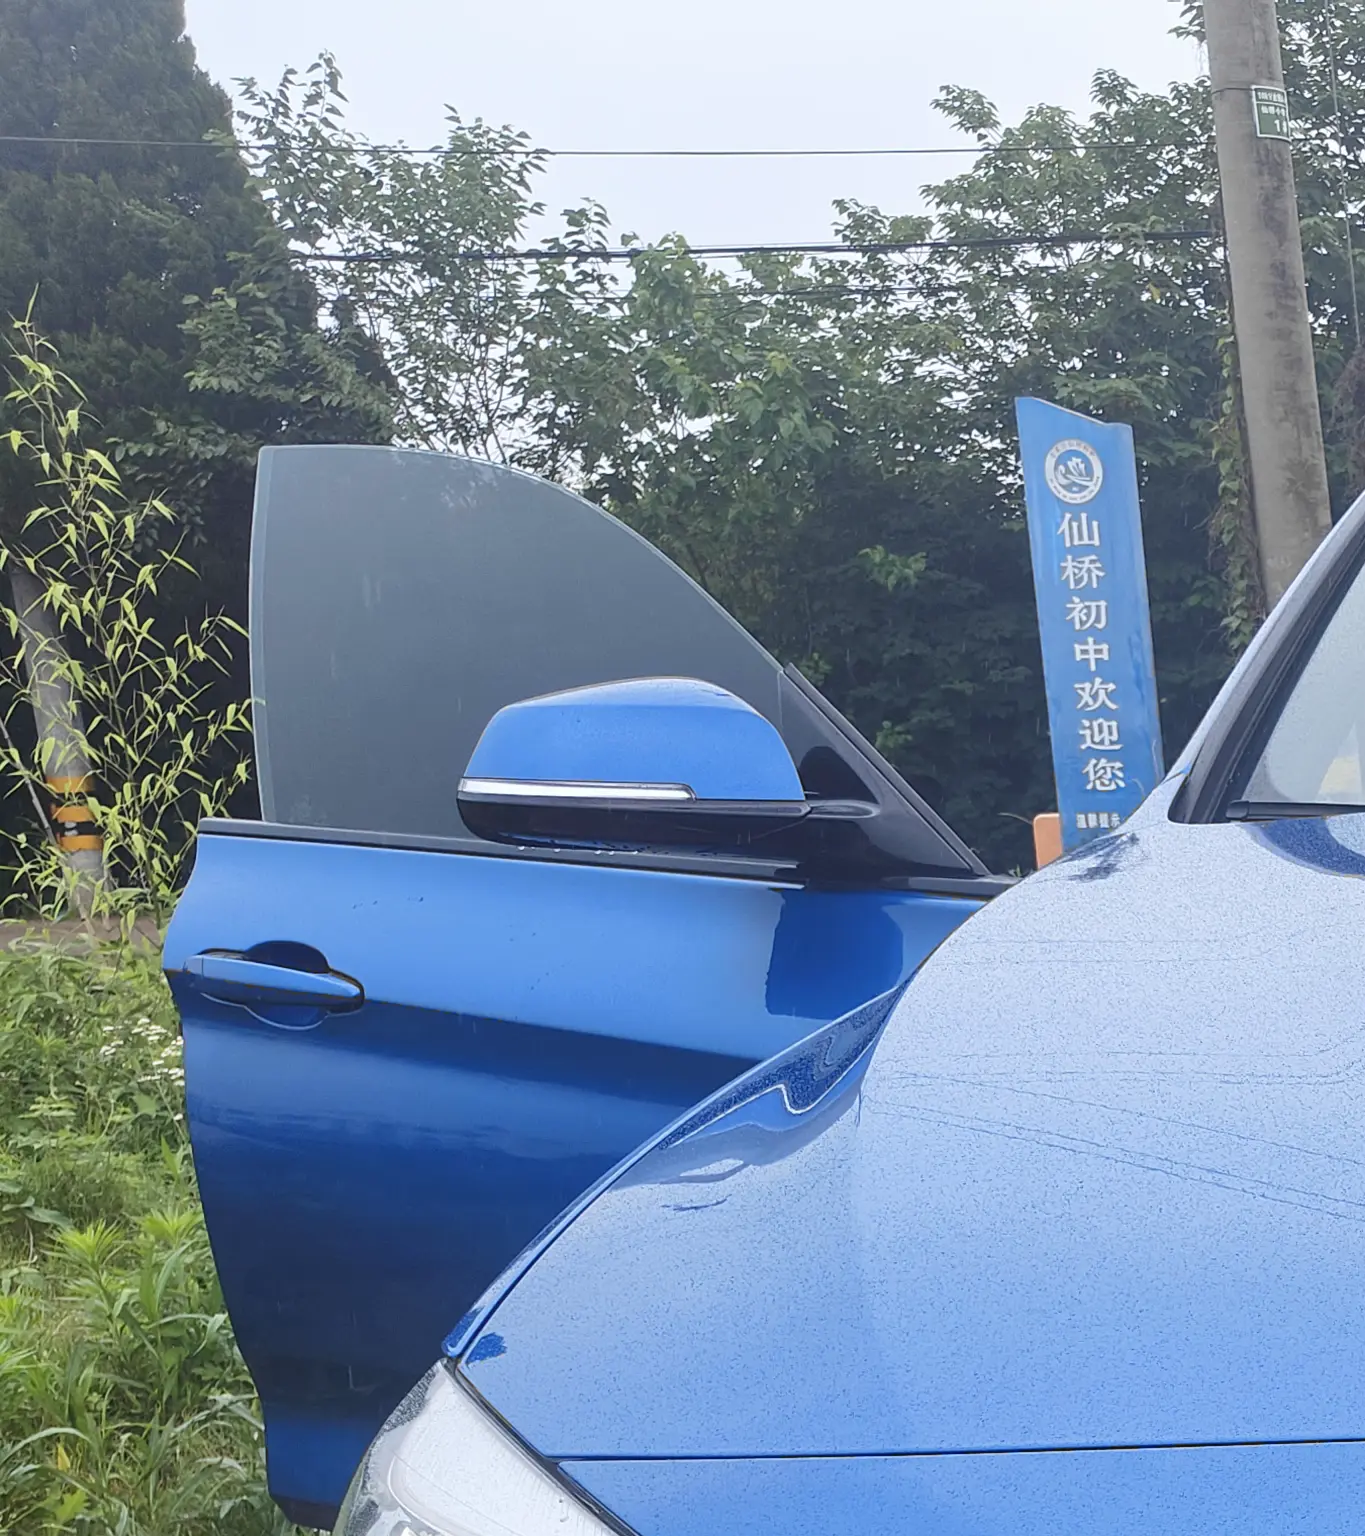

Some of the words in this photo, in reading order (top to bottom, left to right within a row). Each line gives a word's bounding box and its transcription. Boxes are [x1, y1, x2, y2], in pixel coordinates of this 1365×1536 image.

[1057, 511, 1126, 792] 仙桥初中欢迎您
